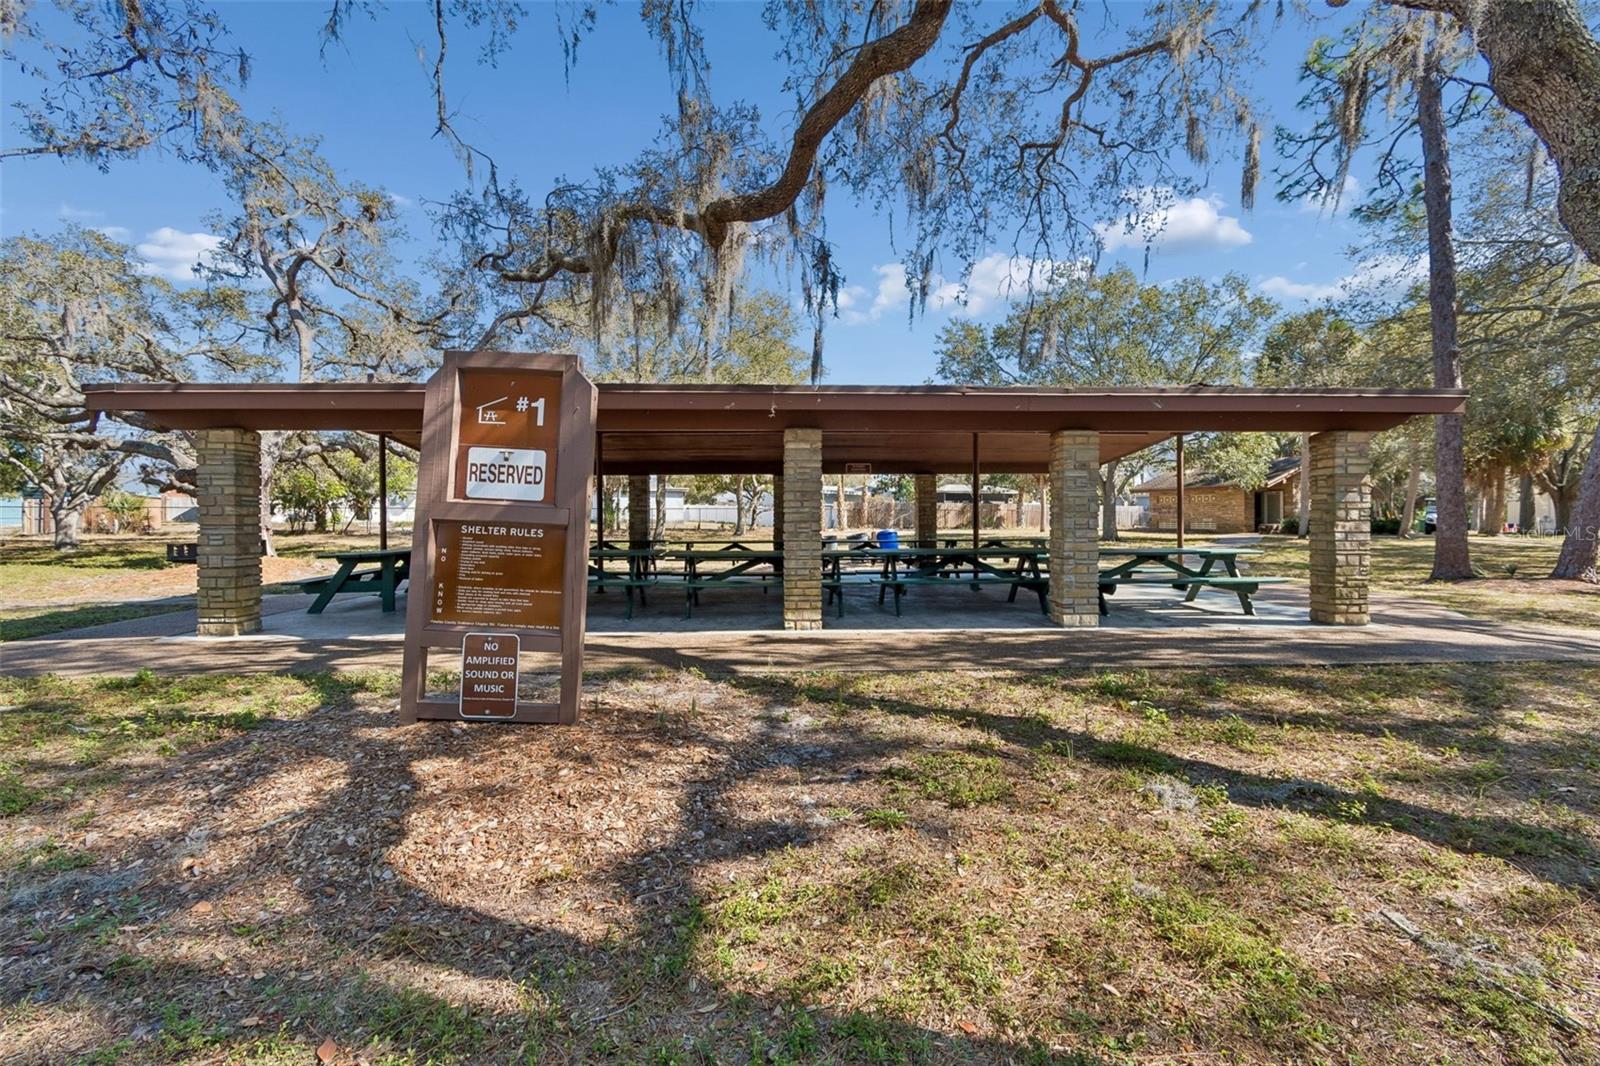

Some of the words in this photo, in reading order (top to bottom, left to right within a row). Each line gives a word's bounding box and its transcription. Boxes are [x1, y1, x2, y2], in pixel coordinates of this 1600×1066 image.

[516, 397, 545, 426] #1
[469, 463, 543, 485] RESERVED
[461, 525, 506, 535] SHELTER
[510, 527, 544, 537] RULES
[484, 643, 498, 651] NO
[466, 656, 515, 665] AMPLIFIED
[465, 670, 498, 679] SOUND
[501, 671, 514, 679] OR
[474, 684, 504, 693] MUSIC
